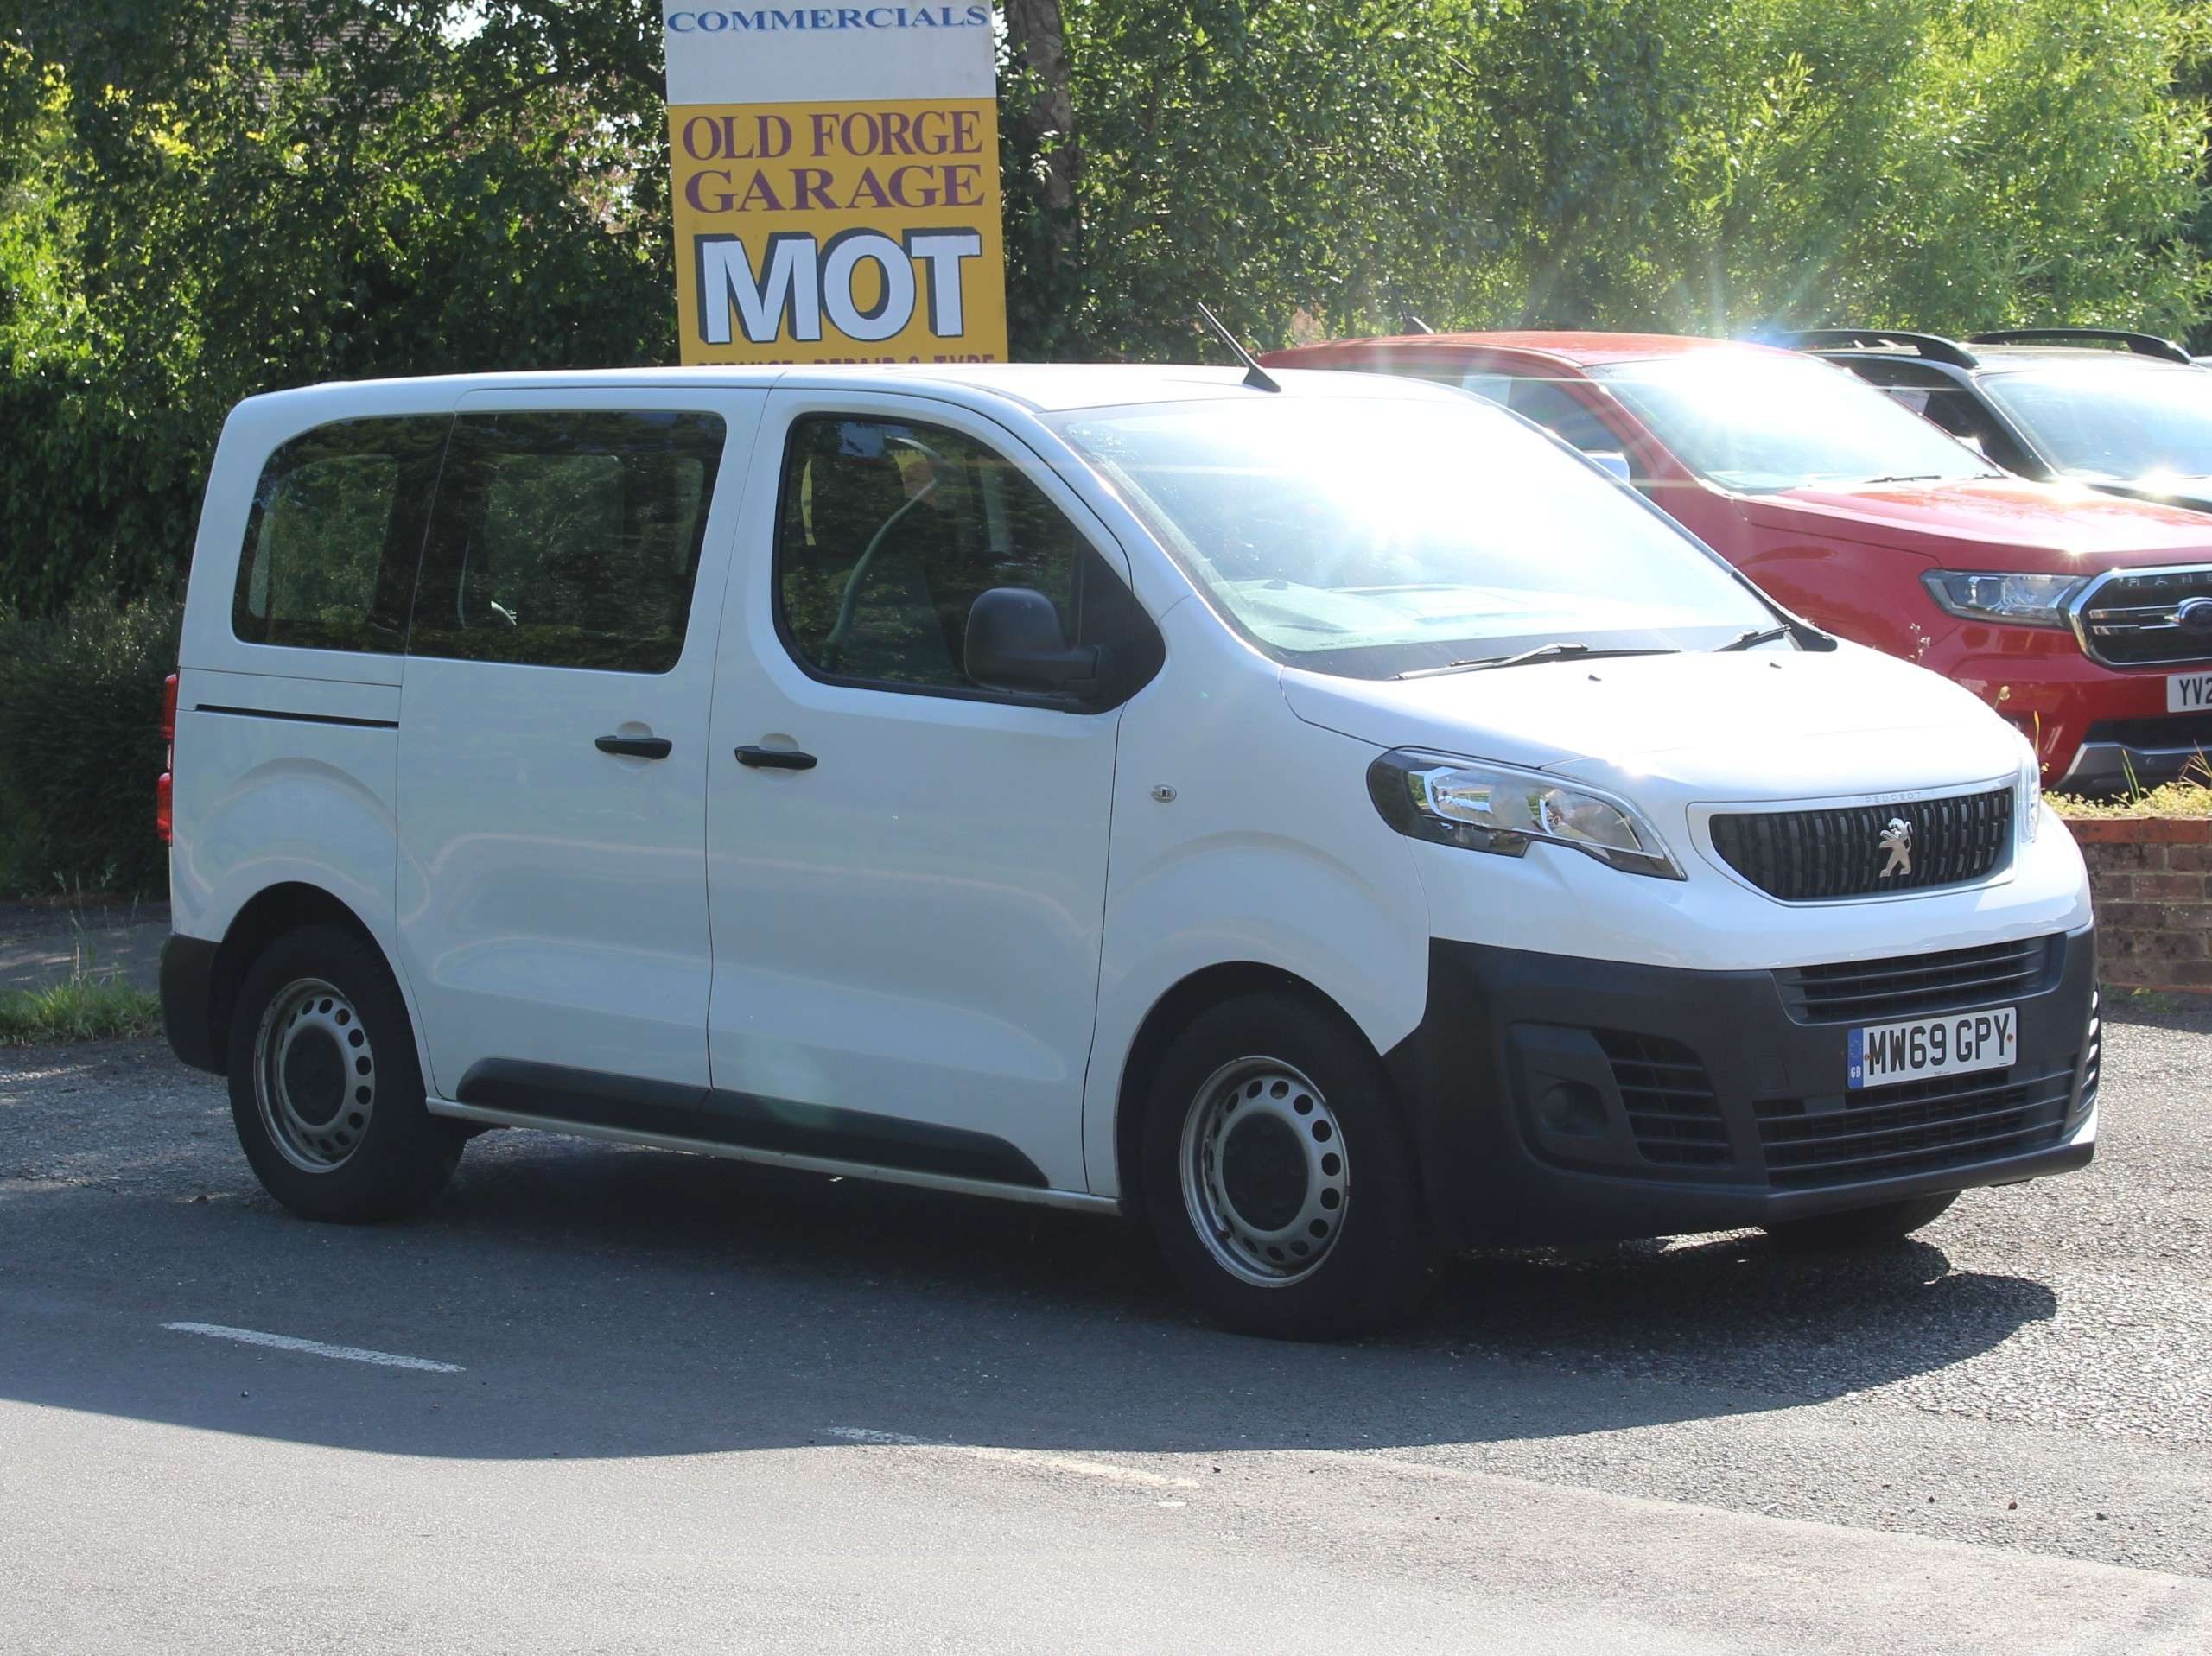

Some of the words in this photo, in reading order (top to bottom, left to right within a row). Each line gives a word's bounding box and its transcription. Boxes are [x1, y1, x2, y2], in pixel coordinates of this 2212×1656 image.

[667, 6, 988, 32] COMMERCIALS
[683, 114, 792, 161] OLD
[809, 111, 983, 157] FORGE
[685, 164, 985, 213] GARAGE
[694, 226, 982, 345] MOT
[1869, 1023, 1948, 1076] MW69
[1955, 1013, 2010, 1063] GPY
[1850, 1065, 1862, 1079] GB
